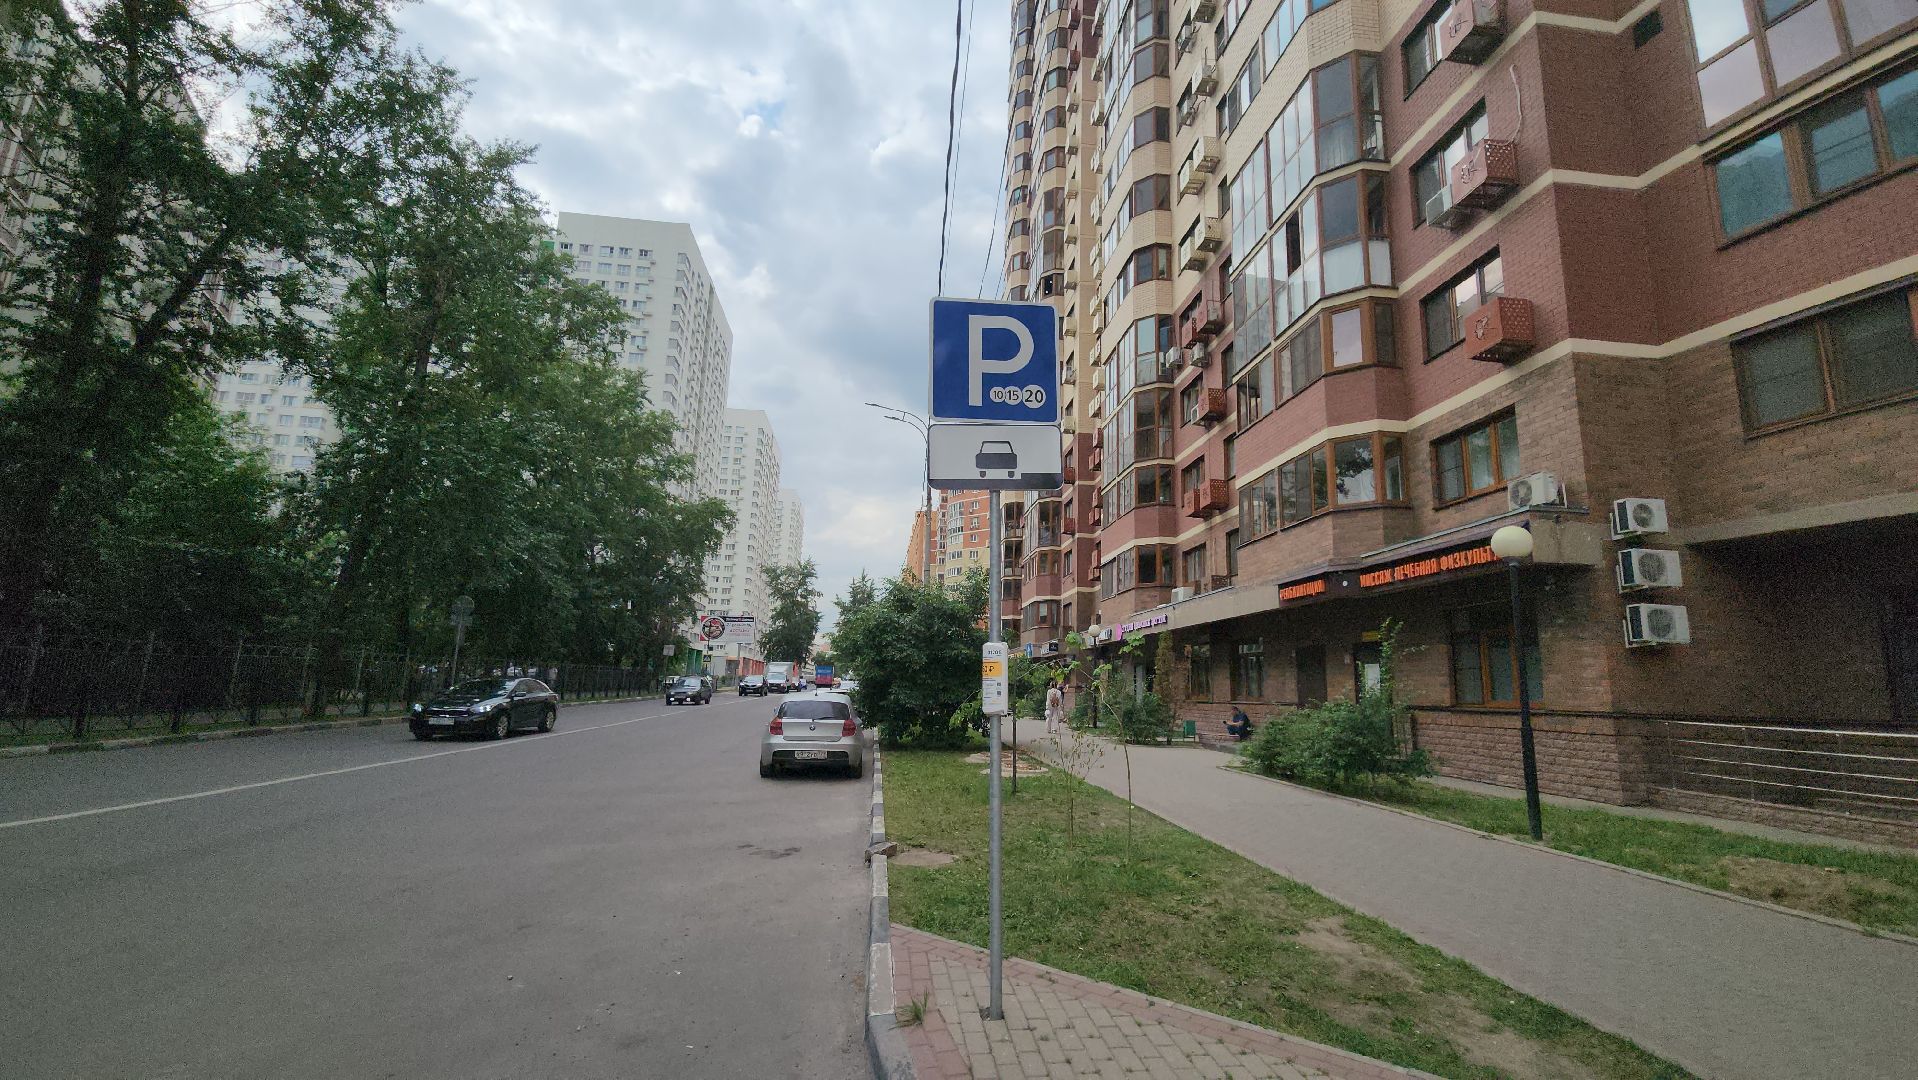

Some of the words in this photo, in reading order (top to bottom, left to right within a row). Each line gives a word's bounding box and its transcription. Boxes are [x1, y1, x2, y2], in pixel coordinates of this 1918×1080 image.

[968, 314, 1035, 407] P
[993, 390, 1004, 400] 10
[1006, 389, 1019, 401] 15
[1024, 389, 1044, 404] 20
[1394, 558, 1438, 581] ЛЕЧЕБНАЯ
[1440, 545, 1500, 571] ФИЗКУЛЬТ
